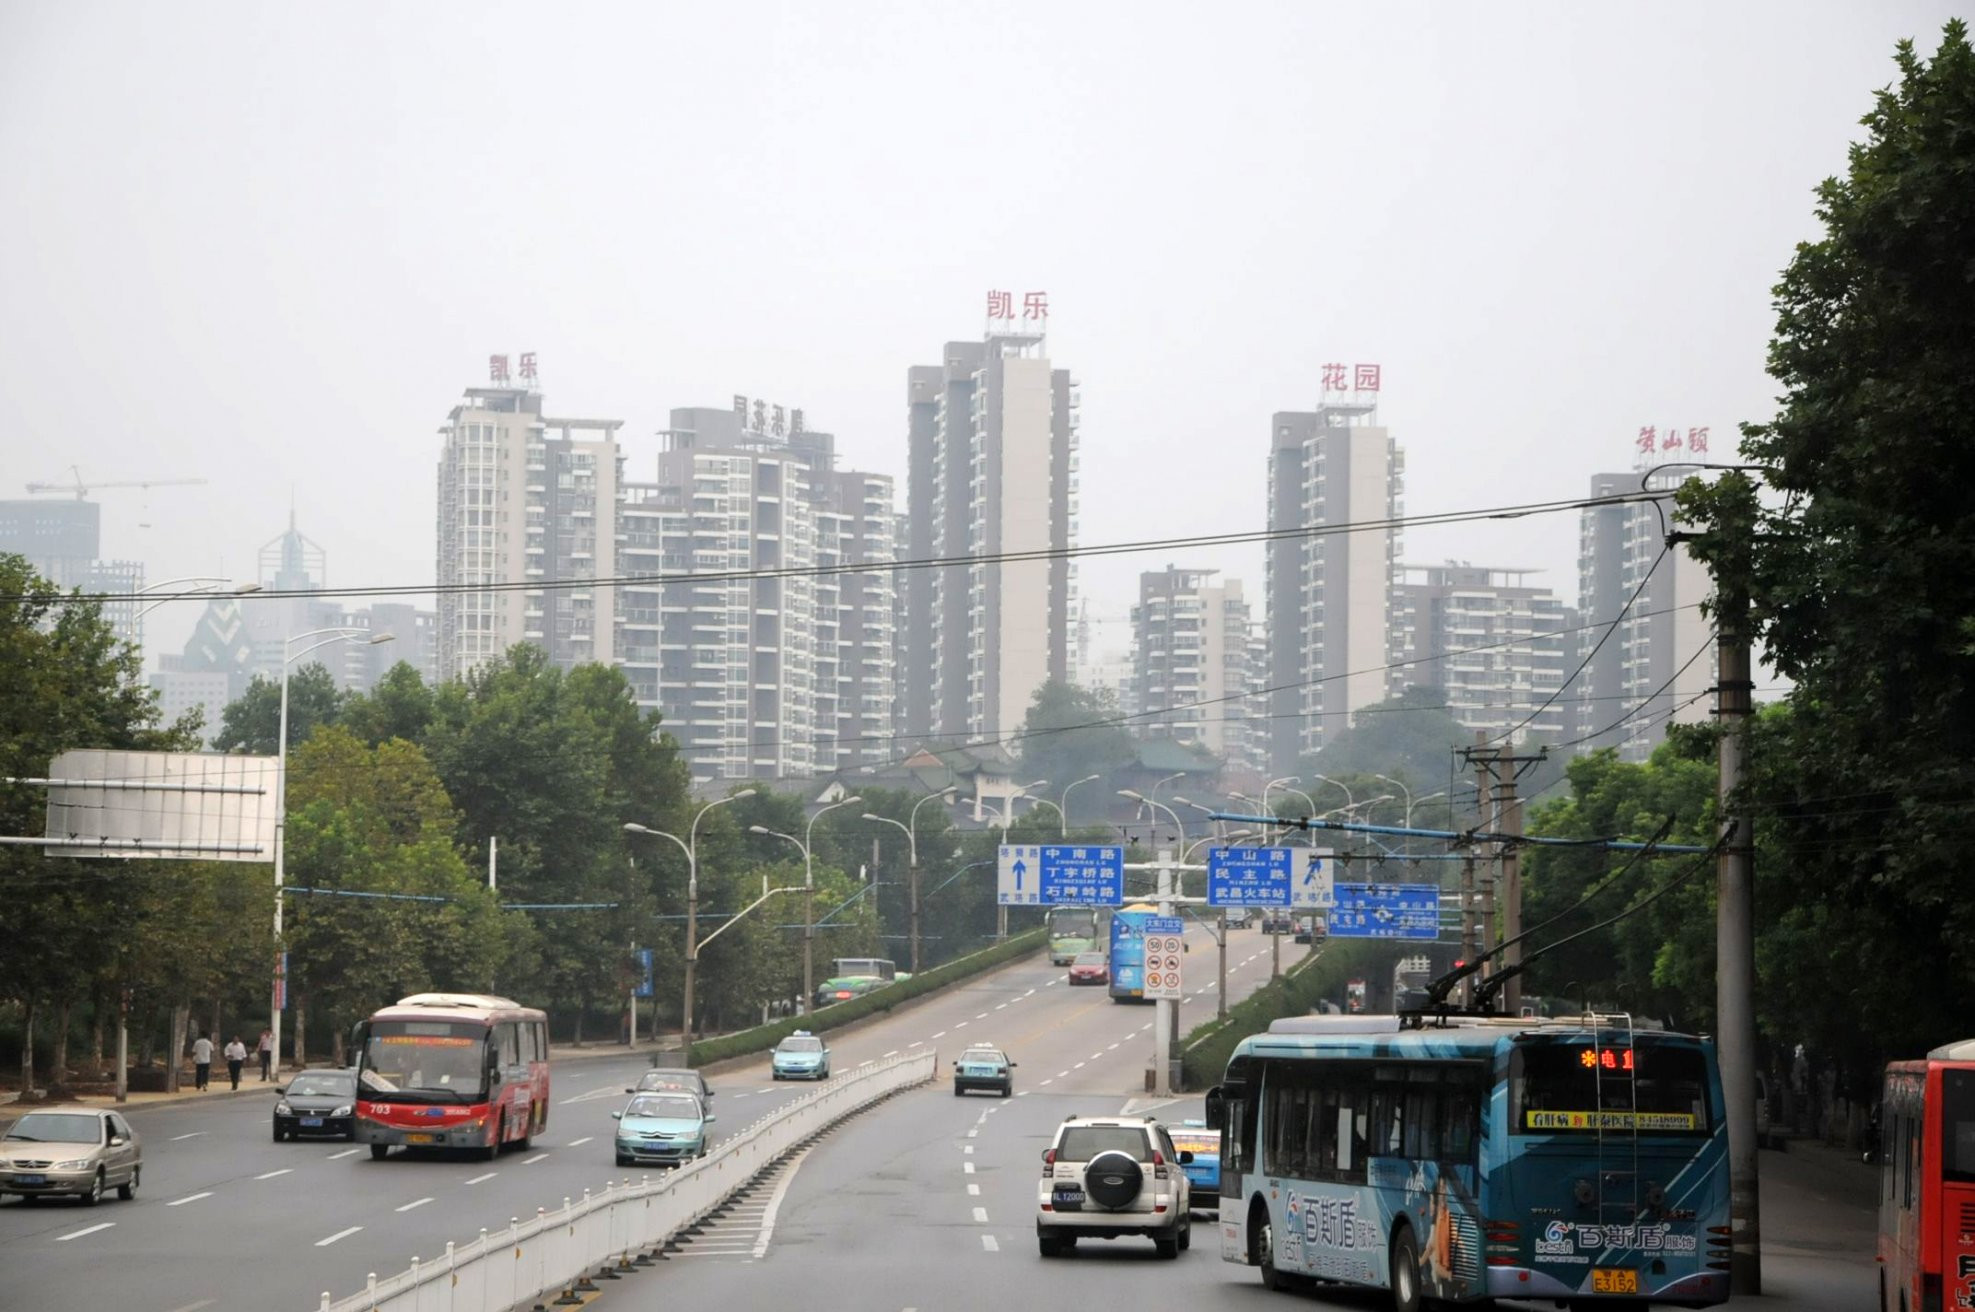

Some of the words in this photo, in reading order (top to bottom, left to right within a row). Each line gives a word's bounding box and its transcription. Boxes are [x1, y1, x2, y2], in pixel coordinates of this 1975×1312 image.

[987, 290, 1049, 320] 凯乐
[490, 352, 537, 381] 凯乐
[1321, 363, 1381, 392] 花园
[1045, 848, 1115, 860] 中南路
[1215, 850, 1285, 861] 中山路
[1045, 867, 1115, 878] 丁字桥路
[1215, 868, 1286, 880] 民主路
[1045, 886, 1115, 897] 石牌岭路
[1215, 887, 1286, 899] 武昌火车站
[370, 1104, 391, 1115] 703
[1303, 1195, 1356, 1249] 百斯盾
[1575, 1224, 1665, 1250] 百斯盾
[1664, 1234, 1697, 1251] 服饰
[1595, 1278, 1635, 1292] E3152
